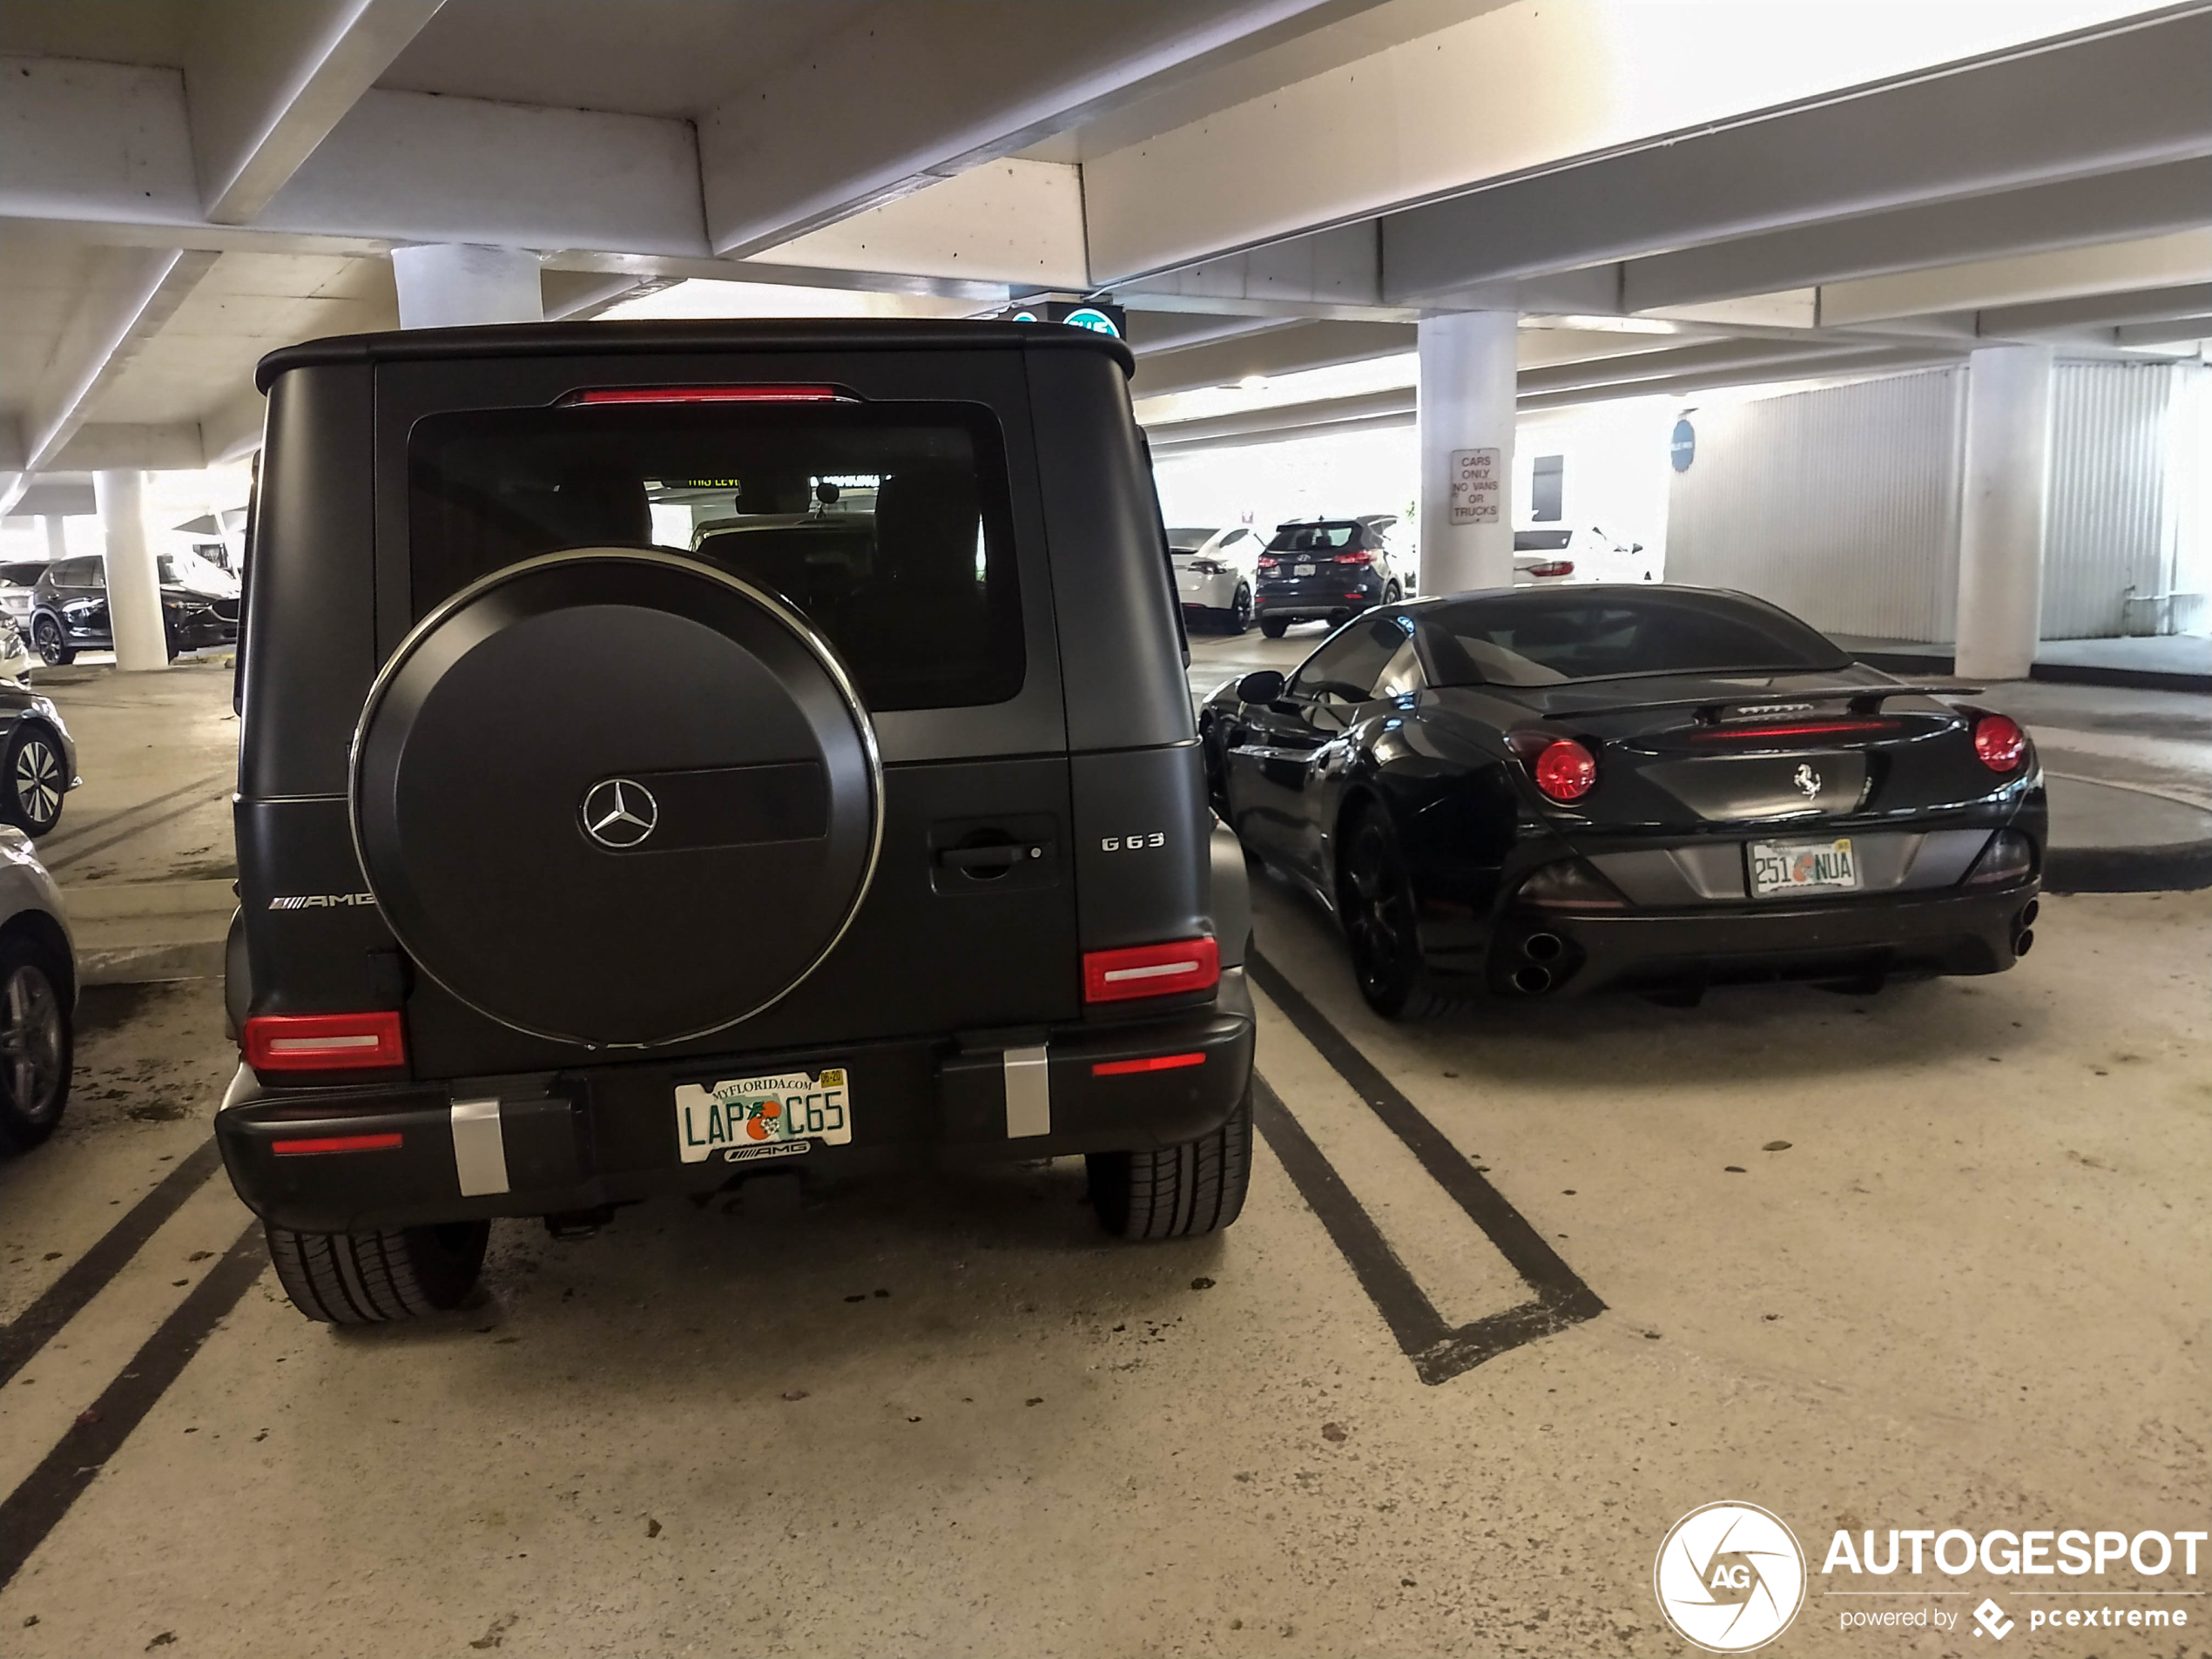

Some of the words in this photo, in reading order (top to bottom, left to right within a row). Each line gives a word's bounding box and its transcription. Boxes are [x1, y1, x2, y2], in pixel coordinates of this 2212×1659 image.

[1461, 456, 1491, 467] CARS
[1462, 469, 1490, 479] ONLY
[1453, 482, 1468, 492] NO
[1473, 481, 1498, 490] VANS
[1468, 494, 1484, 503] OR
[1454, 505, 1497, 517] TRUCKS
[1755, 856, 1791, 884] 251
[1815, 852, 1851, 880] NUA
[712, 1078, 813, 1101] MYFLORIDA.COM
[685, 1102, 744, 1146] LAP
[786, 1090, 844, 1134] C65
[755, 1143, 807, 1156] AMG
